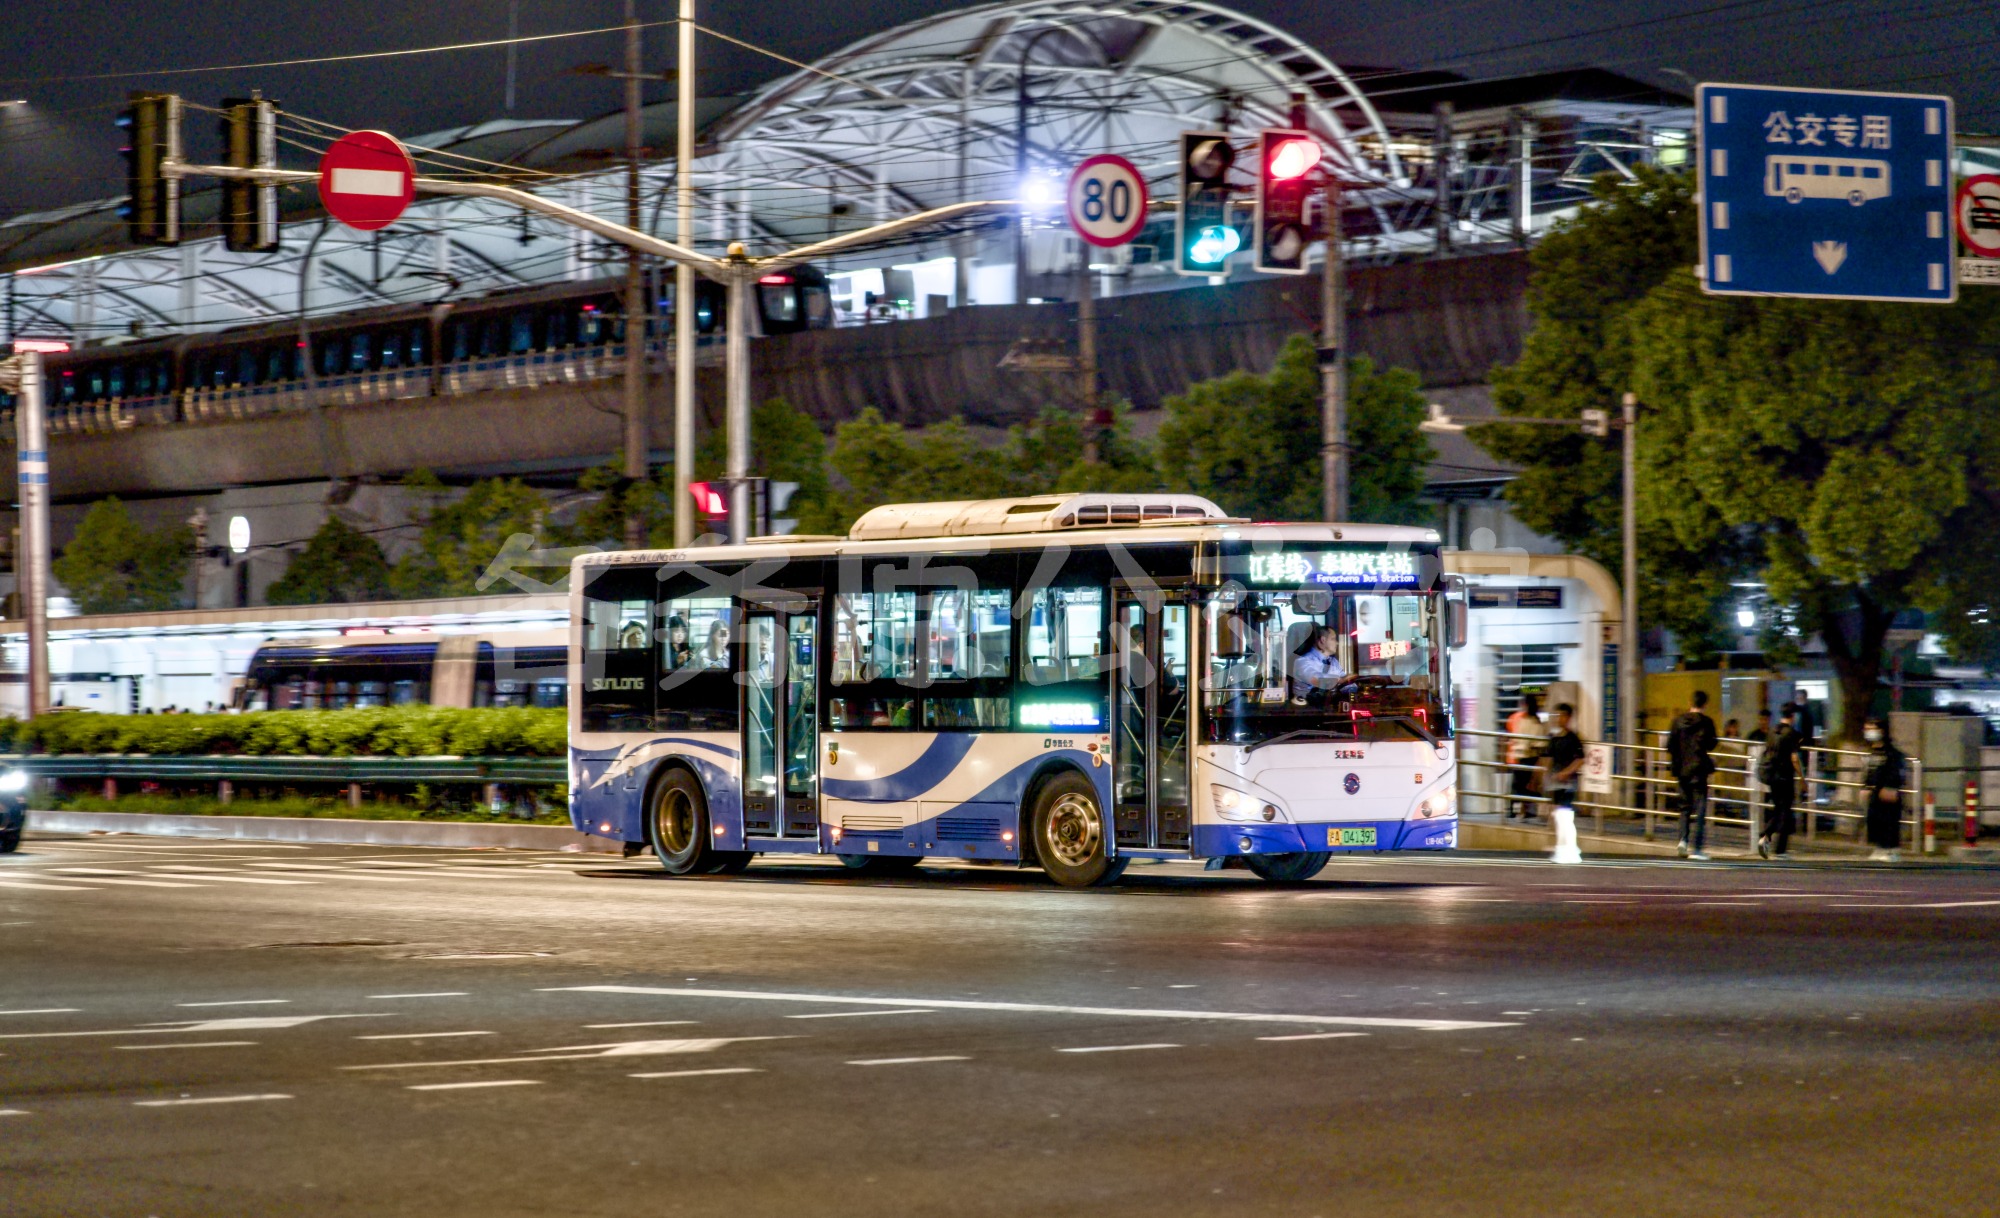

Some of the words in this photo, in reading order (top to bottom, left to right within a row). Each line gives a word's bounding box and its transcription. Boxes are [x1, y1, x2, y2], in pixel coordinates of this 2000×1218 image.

[1762, 110, 1893, 150] 公交专用
[1082, 177, 1130, 223] 80
[1320, 552, 1413, 575] 奉城汽车站
[1316, 574, 1360, 583] Fengcheng
[1363, 574, 1377, 583] Bus
[1380, 574, 1415, 583] Station
[592, 677, 644, 690] SUNLONG
